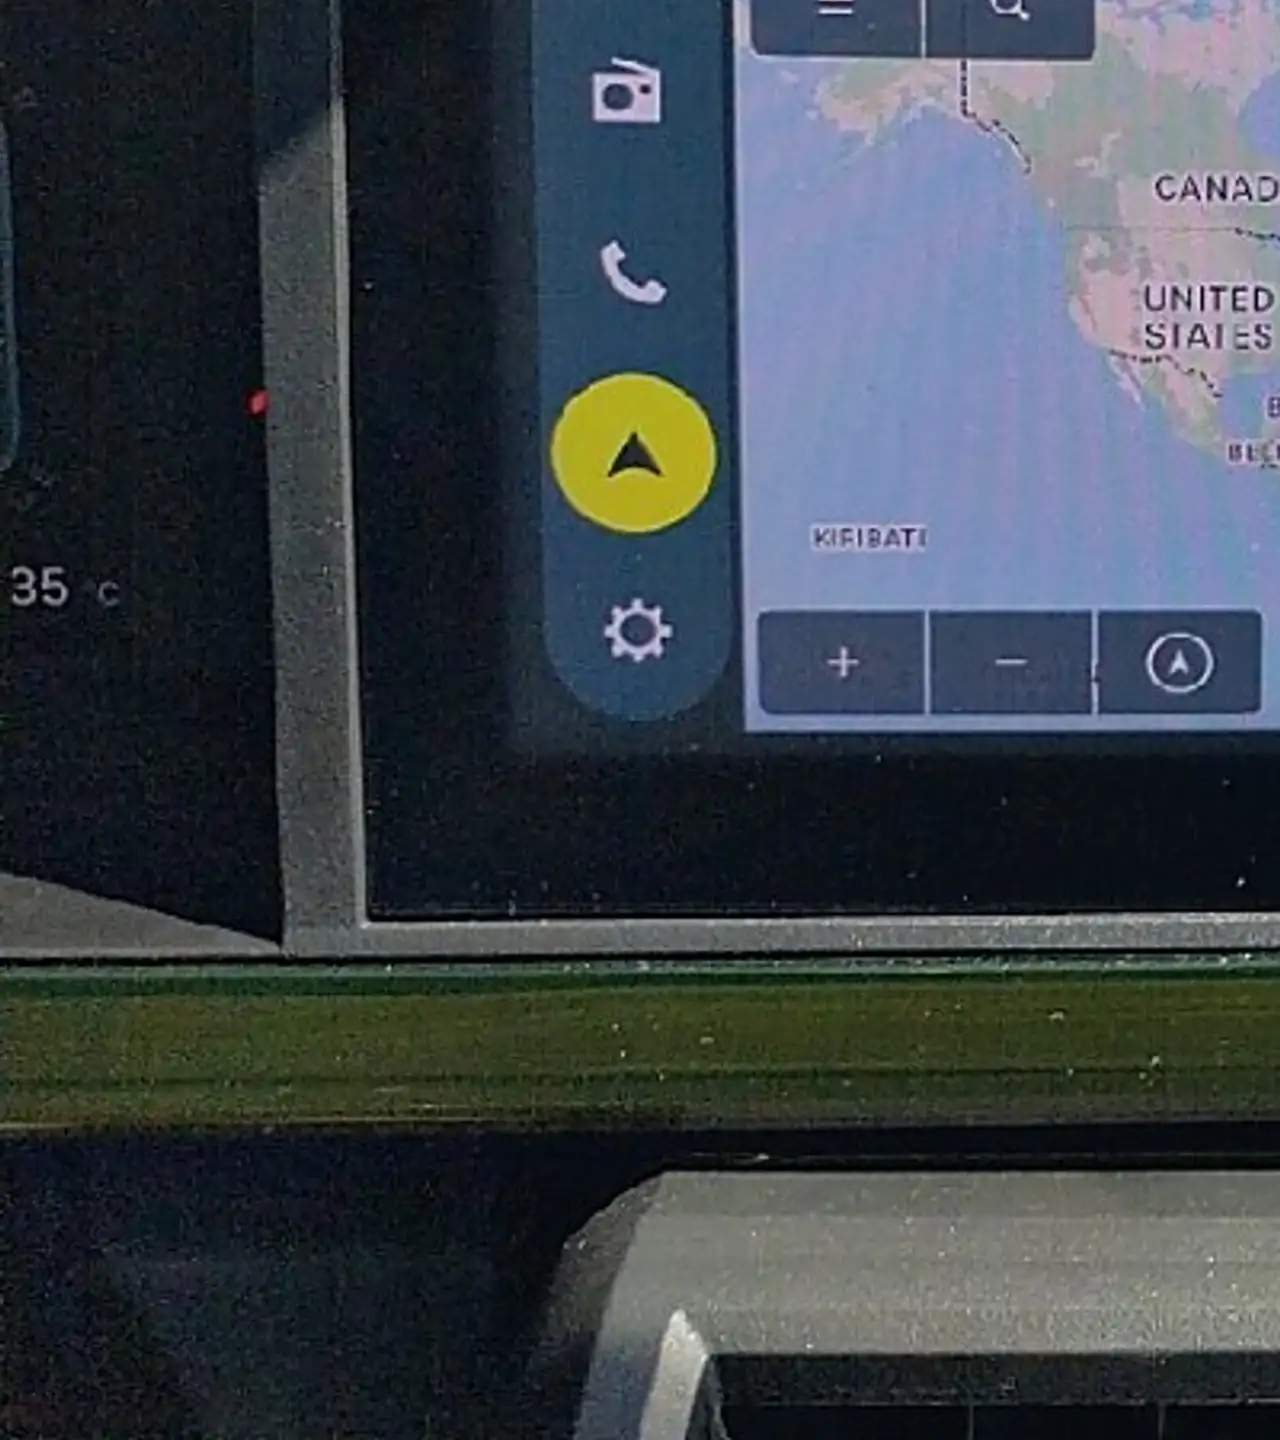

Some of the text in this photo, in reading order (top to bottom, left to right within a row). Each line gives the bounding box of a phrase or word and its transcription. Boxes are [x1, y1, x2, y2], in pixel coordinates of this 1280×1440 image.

[1144, 285, 1275, 313] UNITED
[1144, 323, 1273, 351] STATES
[813, 527, 928, 549] KIRIBATI
[11, 565, 69, 607] 35
